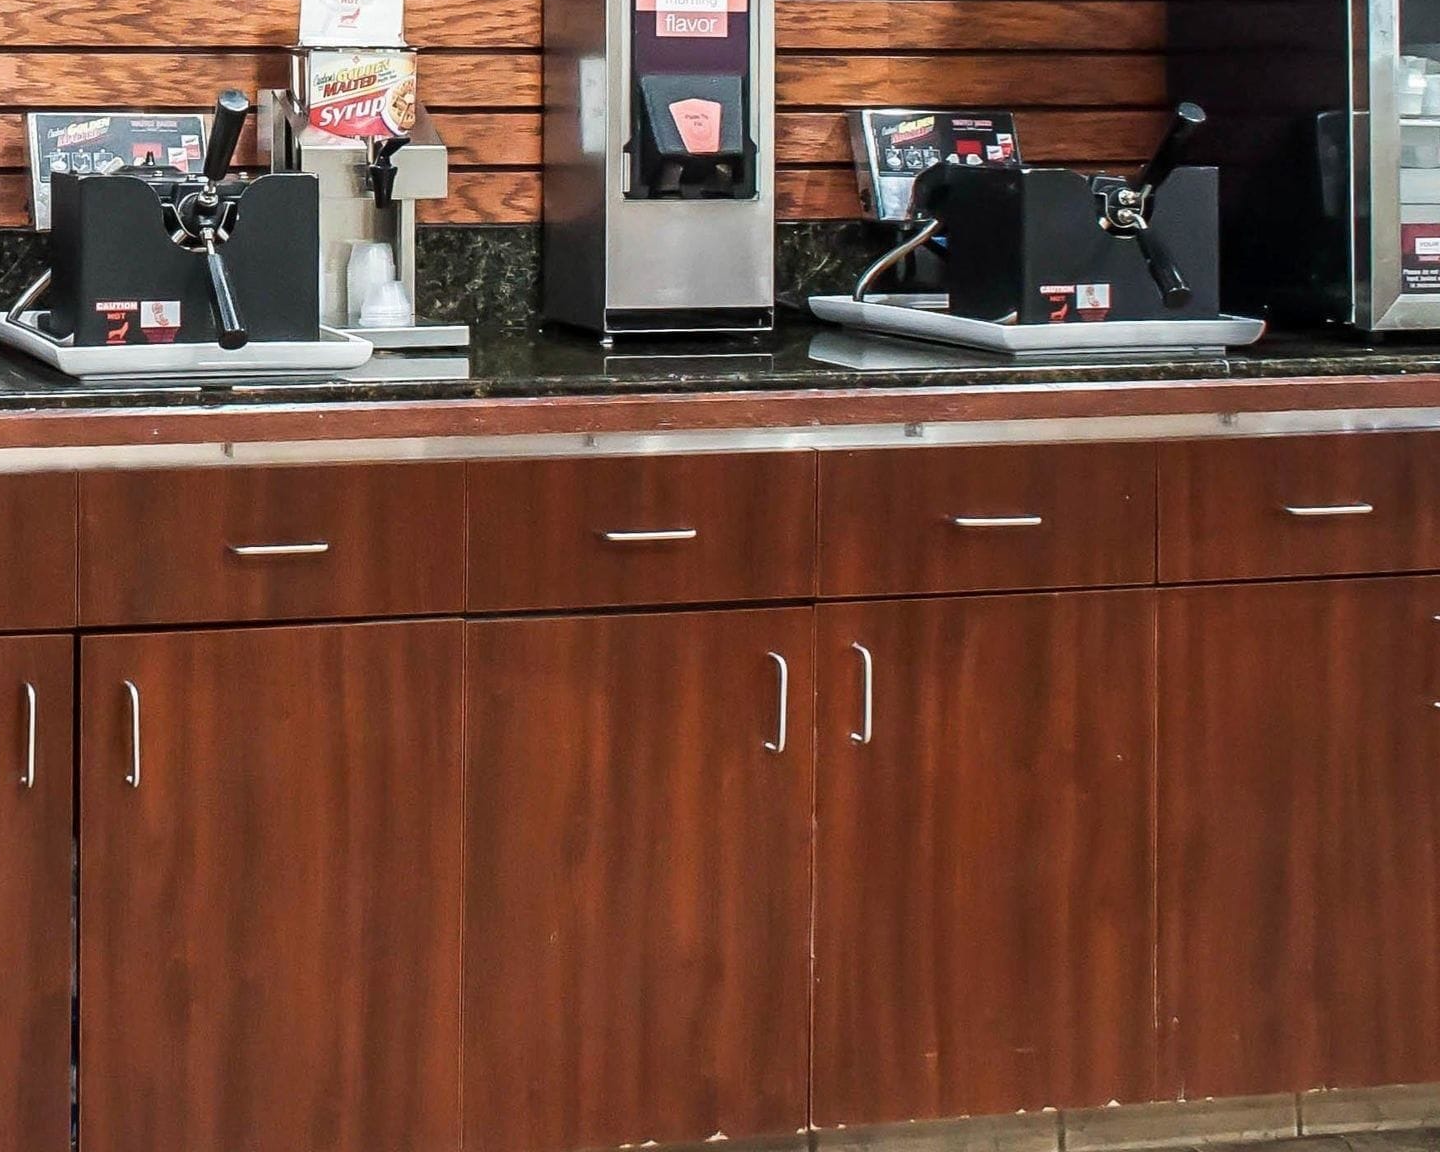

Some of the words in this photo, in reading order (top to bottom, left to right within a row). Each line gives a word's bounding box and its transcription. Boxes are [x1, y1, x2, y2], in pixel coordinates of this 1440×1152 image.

[664, 14, 718, 33] flavor
[323, 74, 377, 98] MALTED
[319, 96, 386, 128] Syrup
[96, 301, 138, 311] CAUTION
